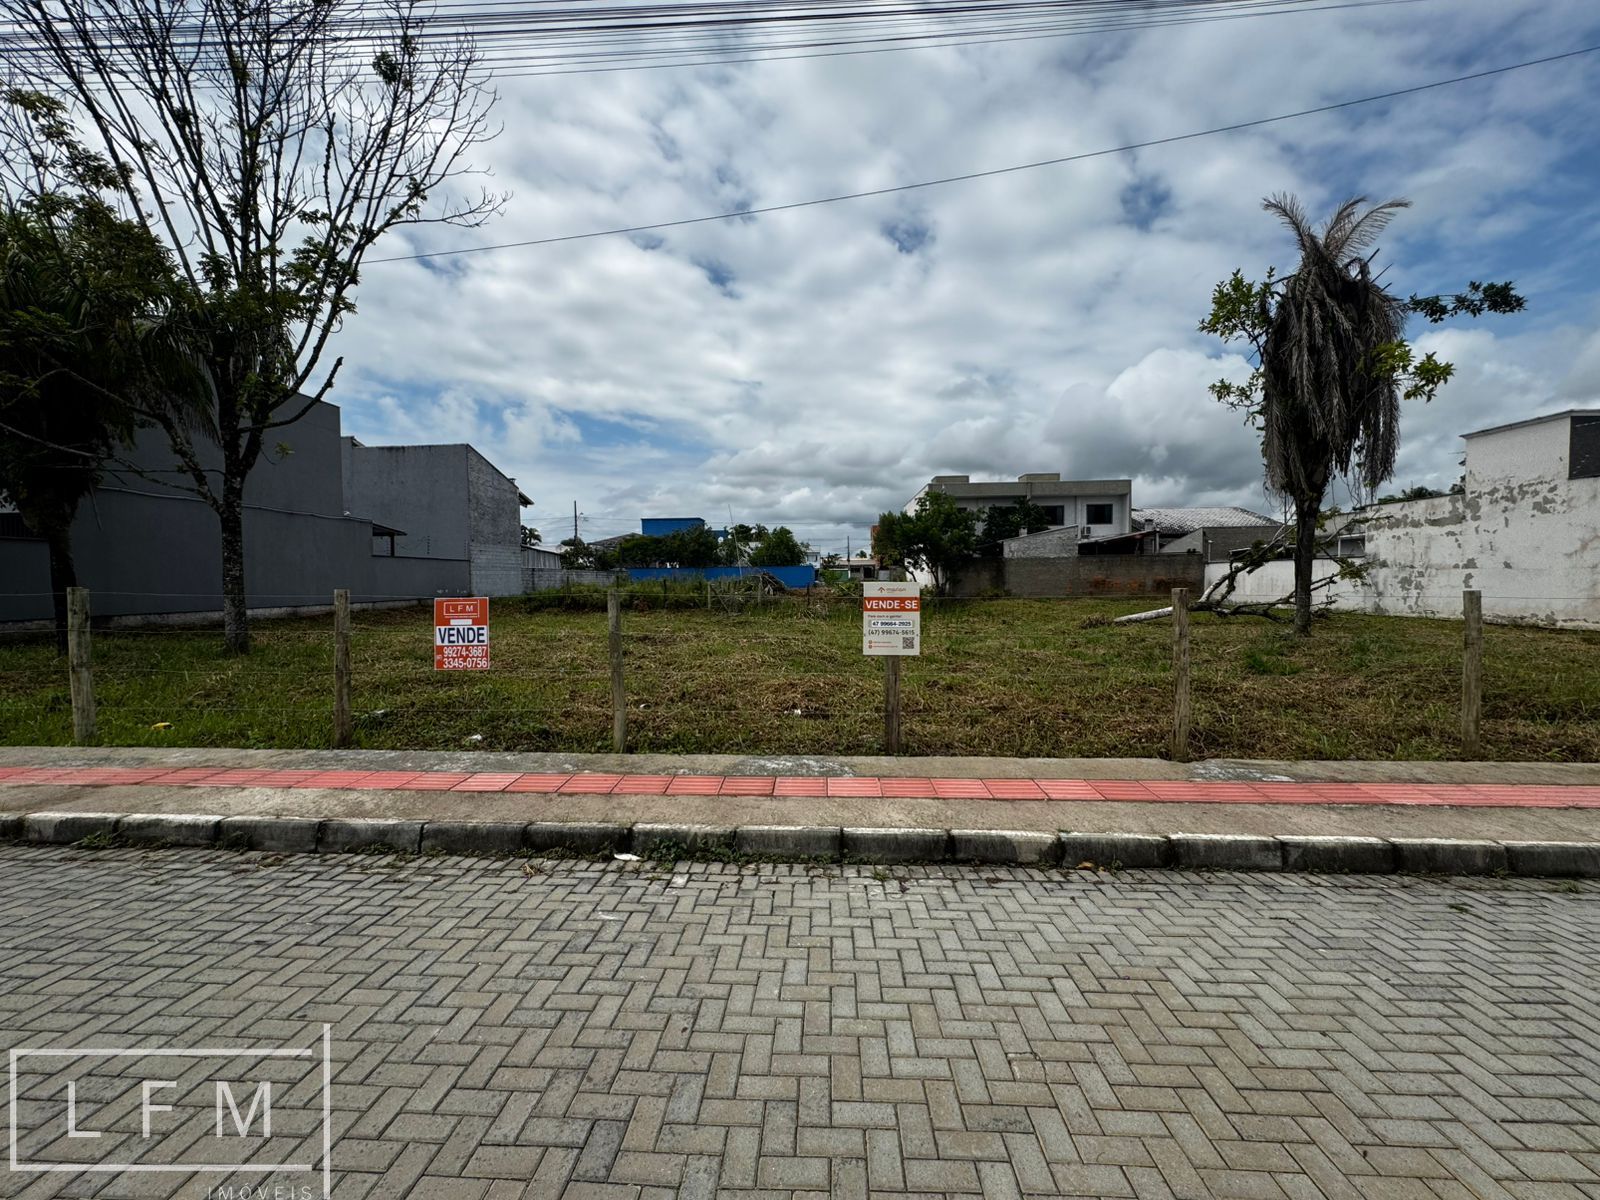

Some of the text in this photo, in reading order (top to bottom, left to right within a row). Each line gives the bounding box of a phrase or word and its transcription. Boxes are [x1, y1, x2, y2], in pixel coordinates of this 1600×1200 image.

[865, 600, 918, 609] VENDE-SE
[438, 627, 485, 643] VENDE
[443, 647, 487, 657] 99274-3687
[443, 658, 487, 668] 3345-0756
